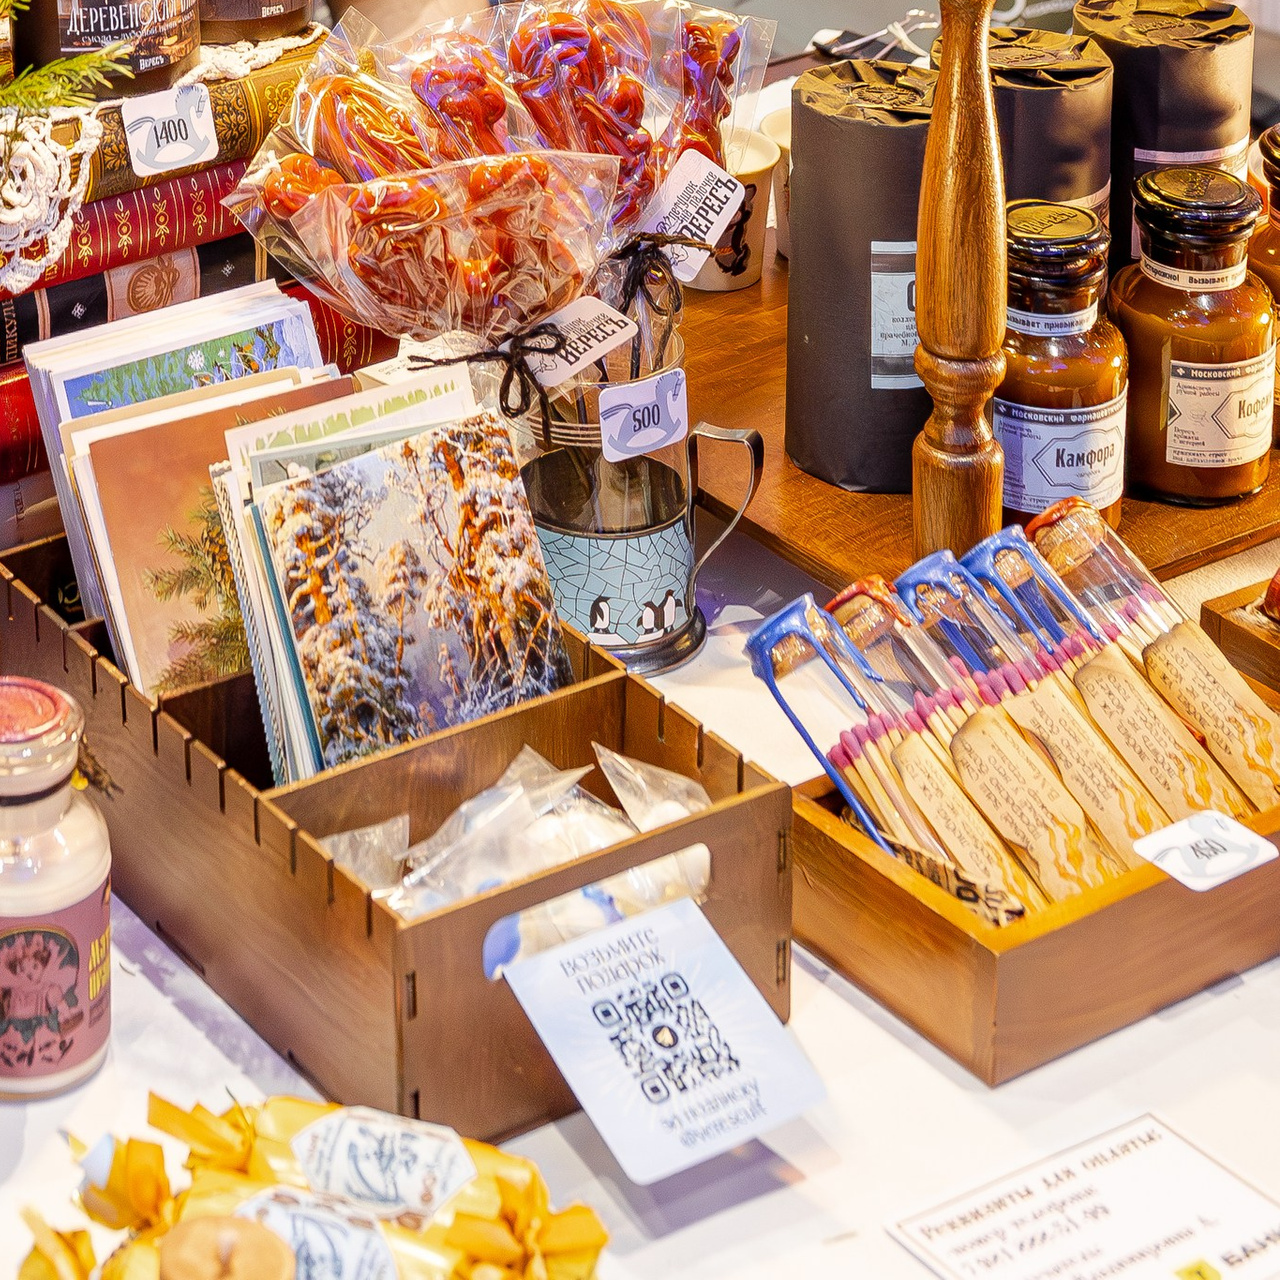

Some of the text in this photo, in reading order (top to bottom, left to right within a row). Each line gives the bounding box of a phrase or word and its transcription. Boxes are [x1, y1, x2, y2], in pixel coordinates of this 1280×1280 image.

[152, 118, 189, 148] 1400
[632, 403, 661, 433] 500
[1055, 443, 1115, 468] Камфора
